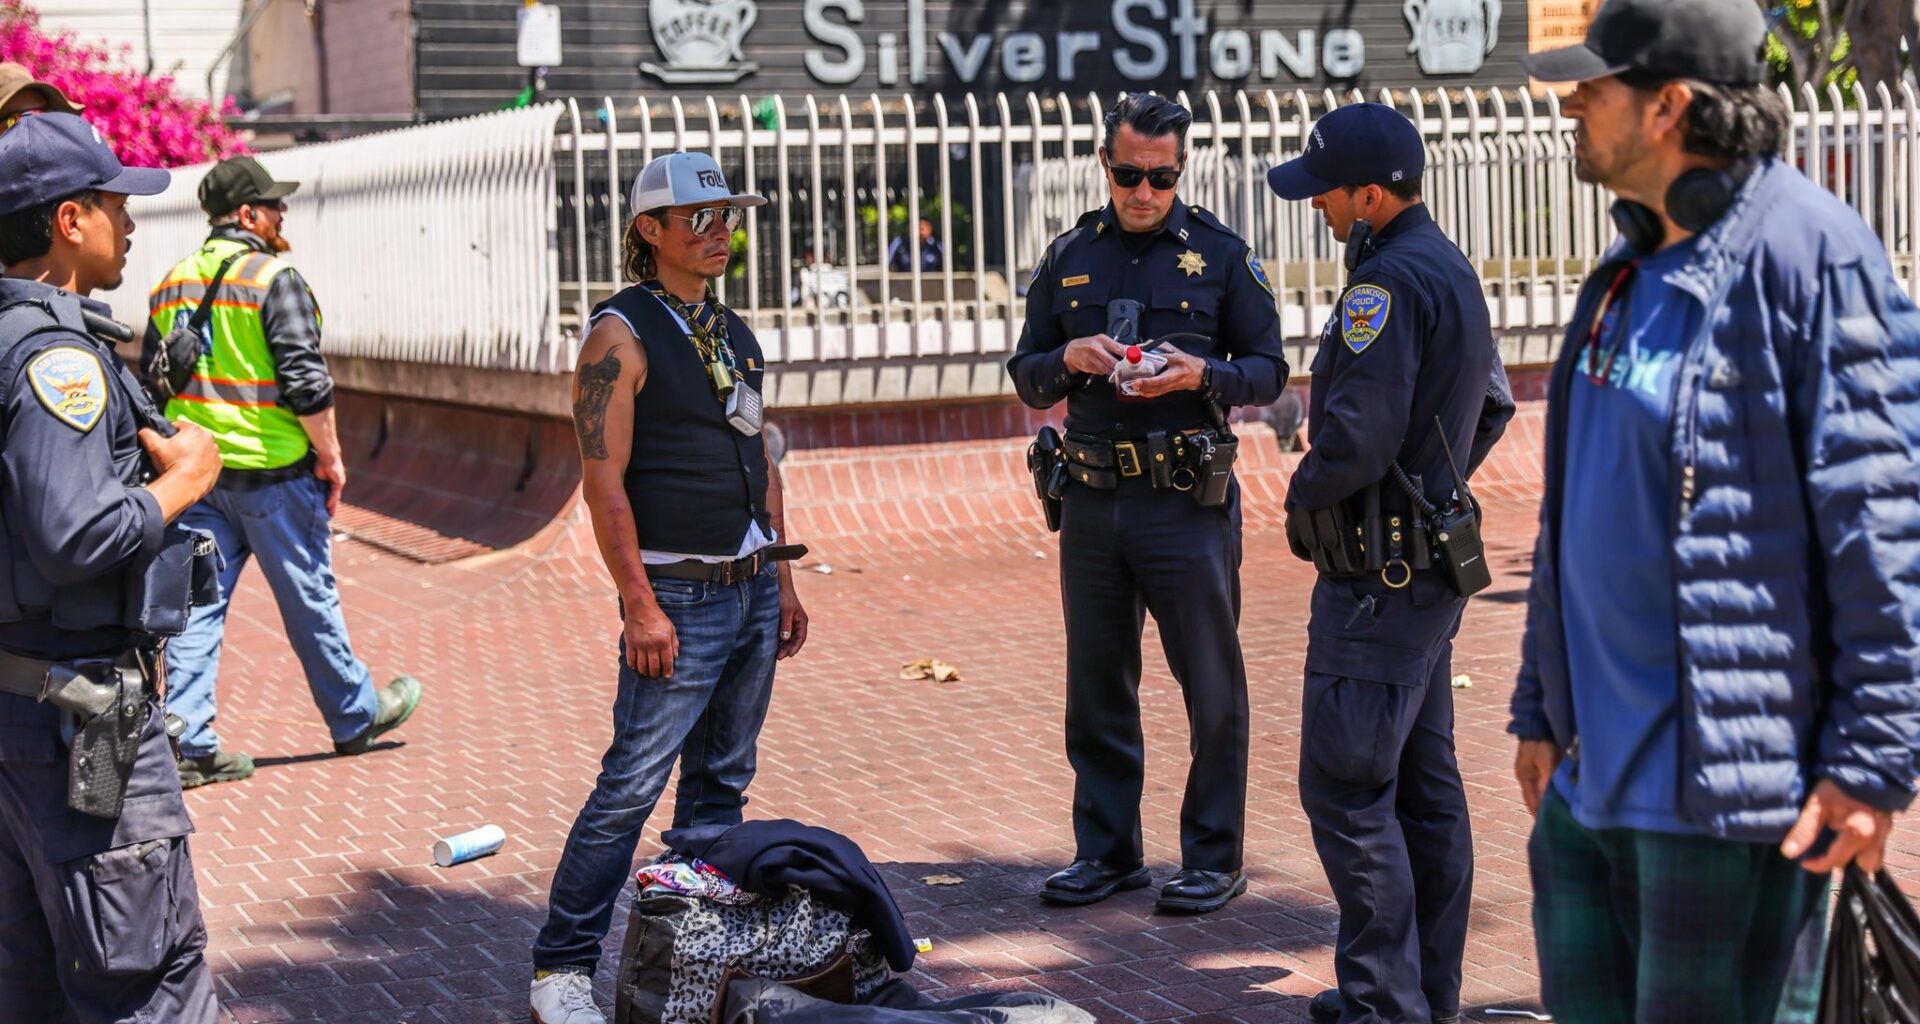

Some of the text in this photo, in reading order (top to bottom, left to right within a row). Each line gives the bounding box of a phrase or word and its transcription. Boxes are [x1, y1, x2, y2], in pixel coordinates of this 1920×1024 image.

[659, 11, 732, 44] COFFEE
[1352, 297, 1375, 305] POLICE
[1354, 288, 1387, 301] FRANCISCO
[745, 393, 760, 419] JBL
